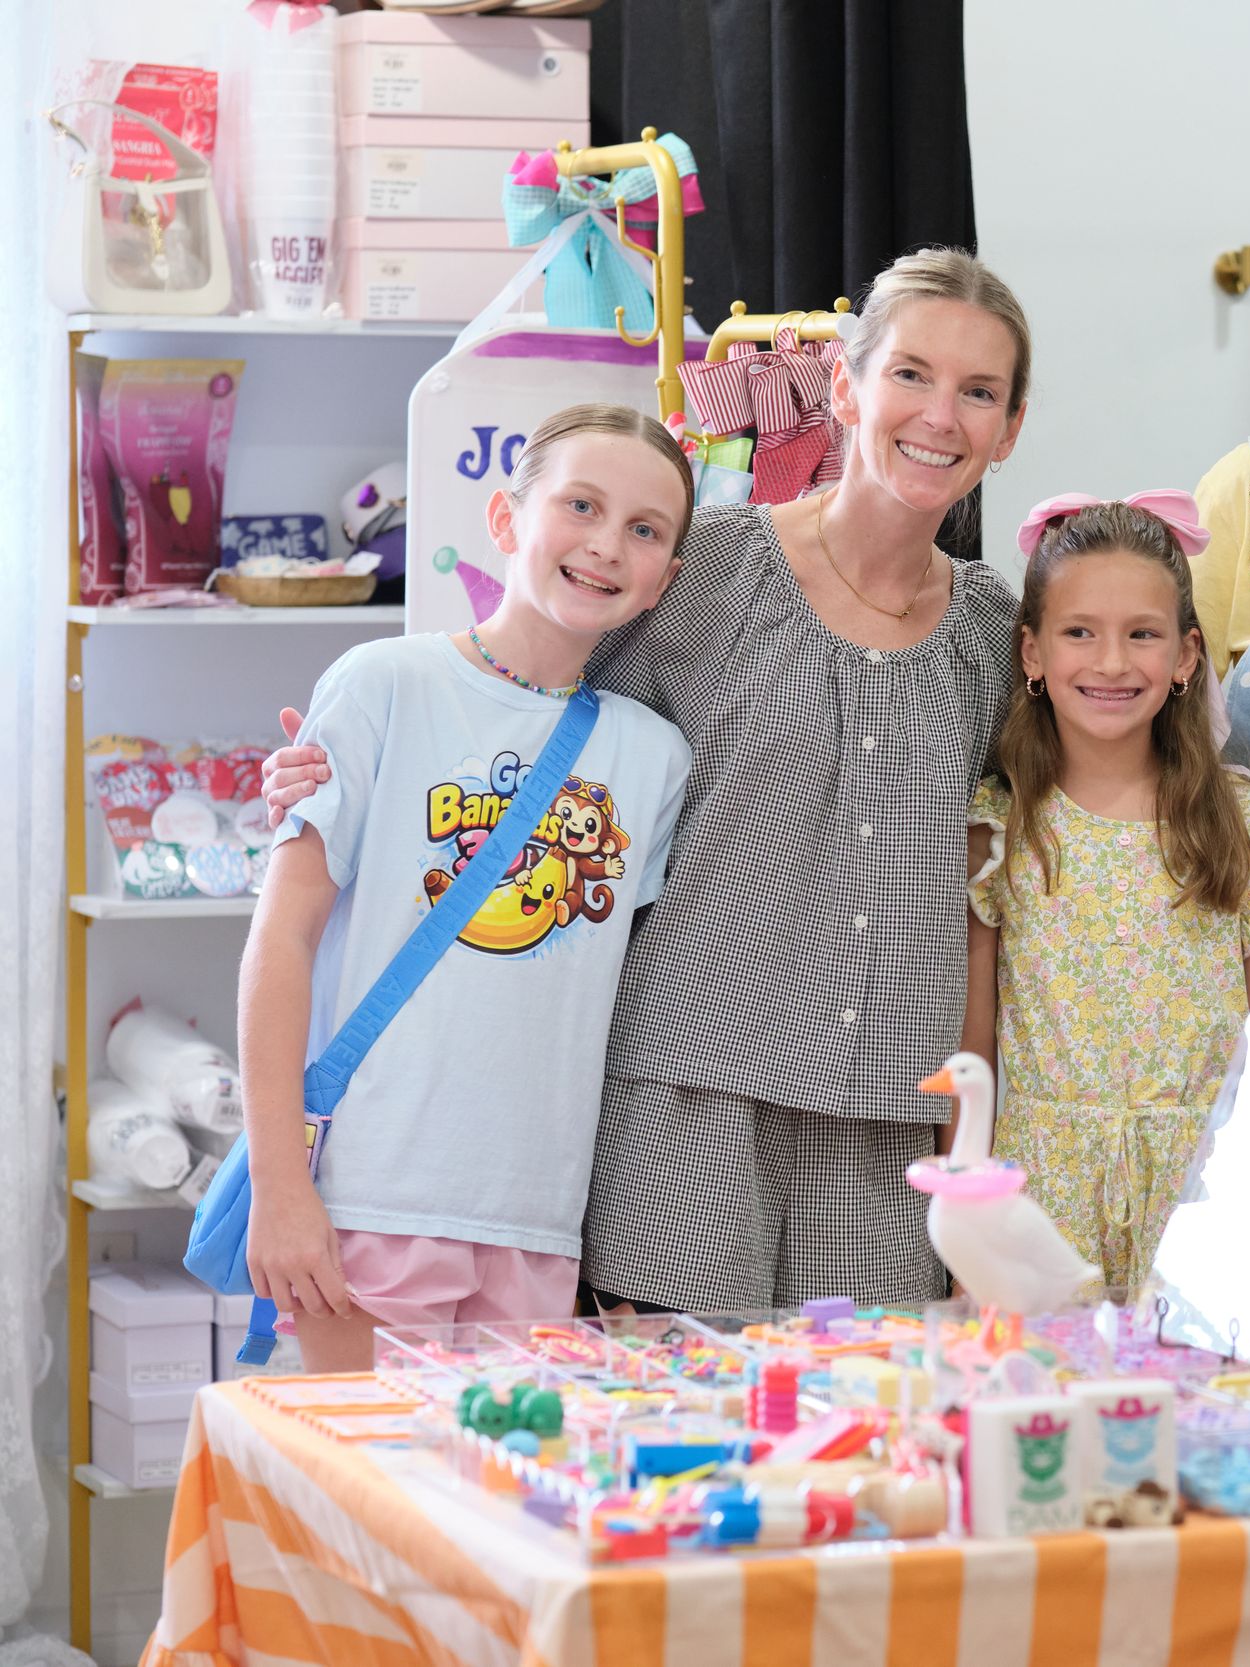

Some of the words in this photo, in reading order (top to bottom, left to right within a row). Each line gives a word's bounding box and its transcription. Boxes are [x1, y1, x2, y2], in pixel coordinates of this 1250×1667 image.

[271, 236, 300, 262] GIG
[238, 534, 307, 559] GAME
[322, 972, 401, 1078] ATHLET
